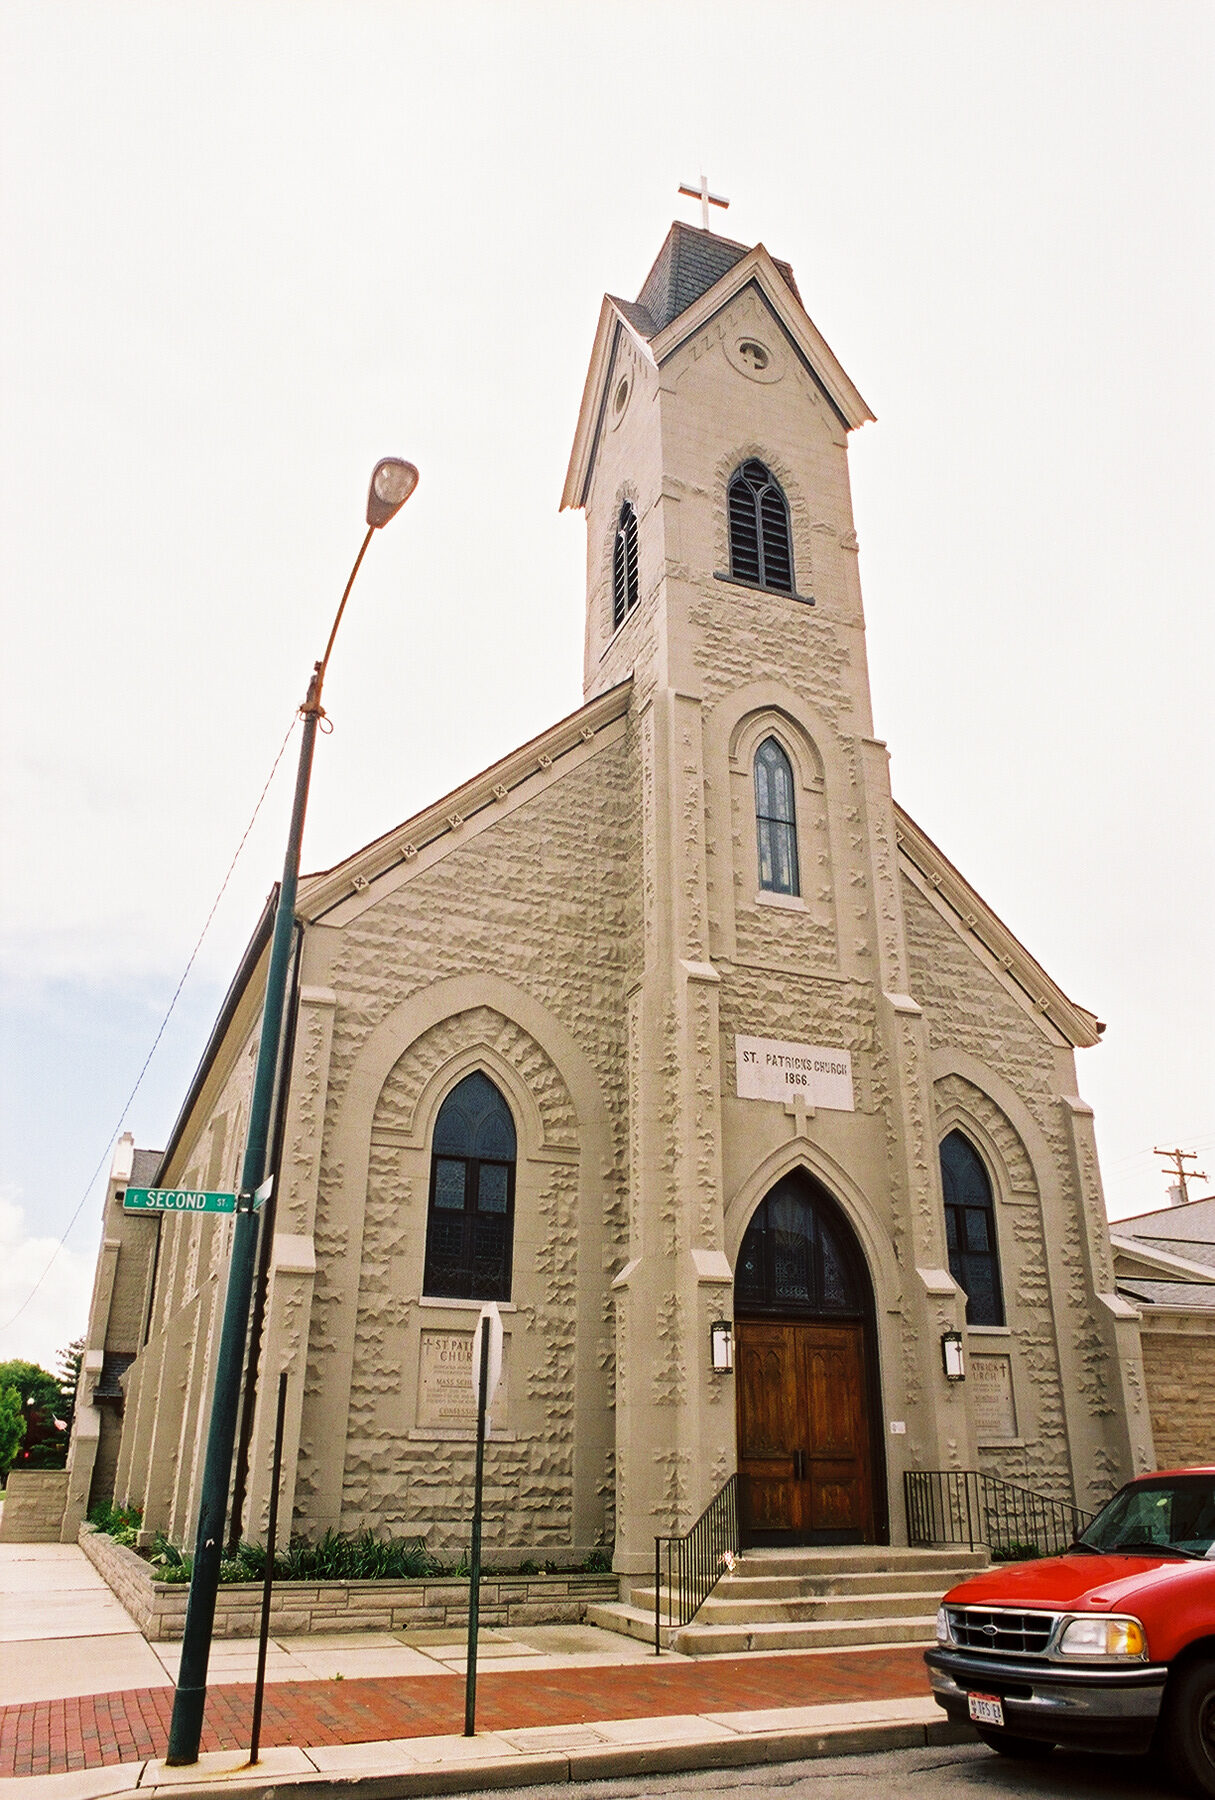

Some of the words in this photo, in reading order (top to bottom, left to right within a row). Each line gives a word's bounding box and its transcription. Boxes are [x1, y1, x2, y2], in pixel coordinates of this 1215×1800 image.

[743, 1051, 759, 1064] ST.
[814, 1061, 847, 1076] CHURCH
[133, 1195, 139, 1203] E
[145, 1191, 206, 1209] SECOND
[435, 1339, 448, 1350] ST
[440, 1351, 473, 1362] CHUR
